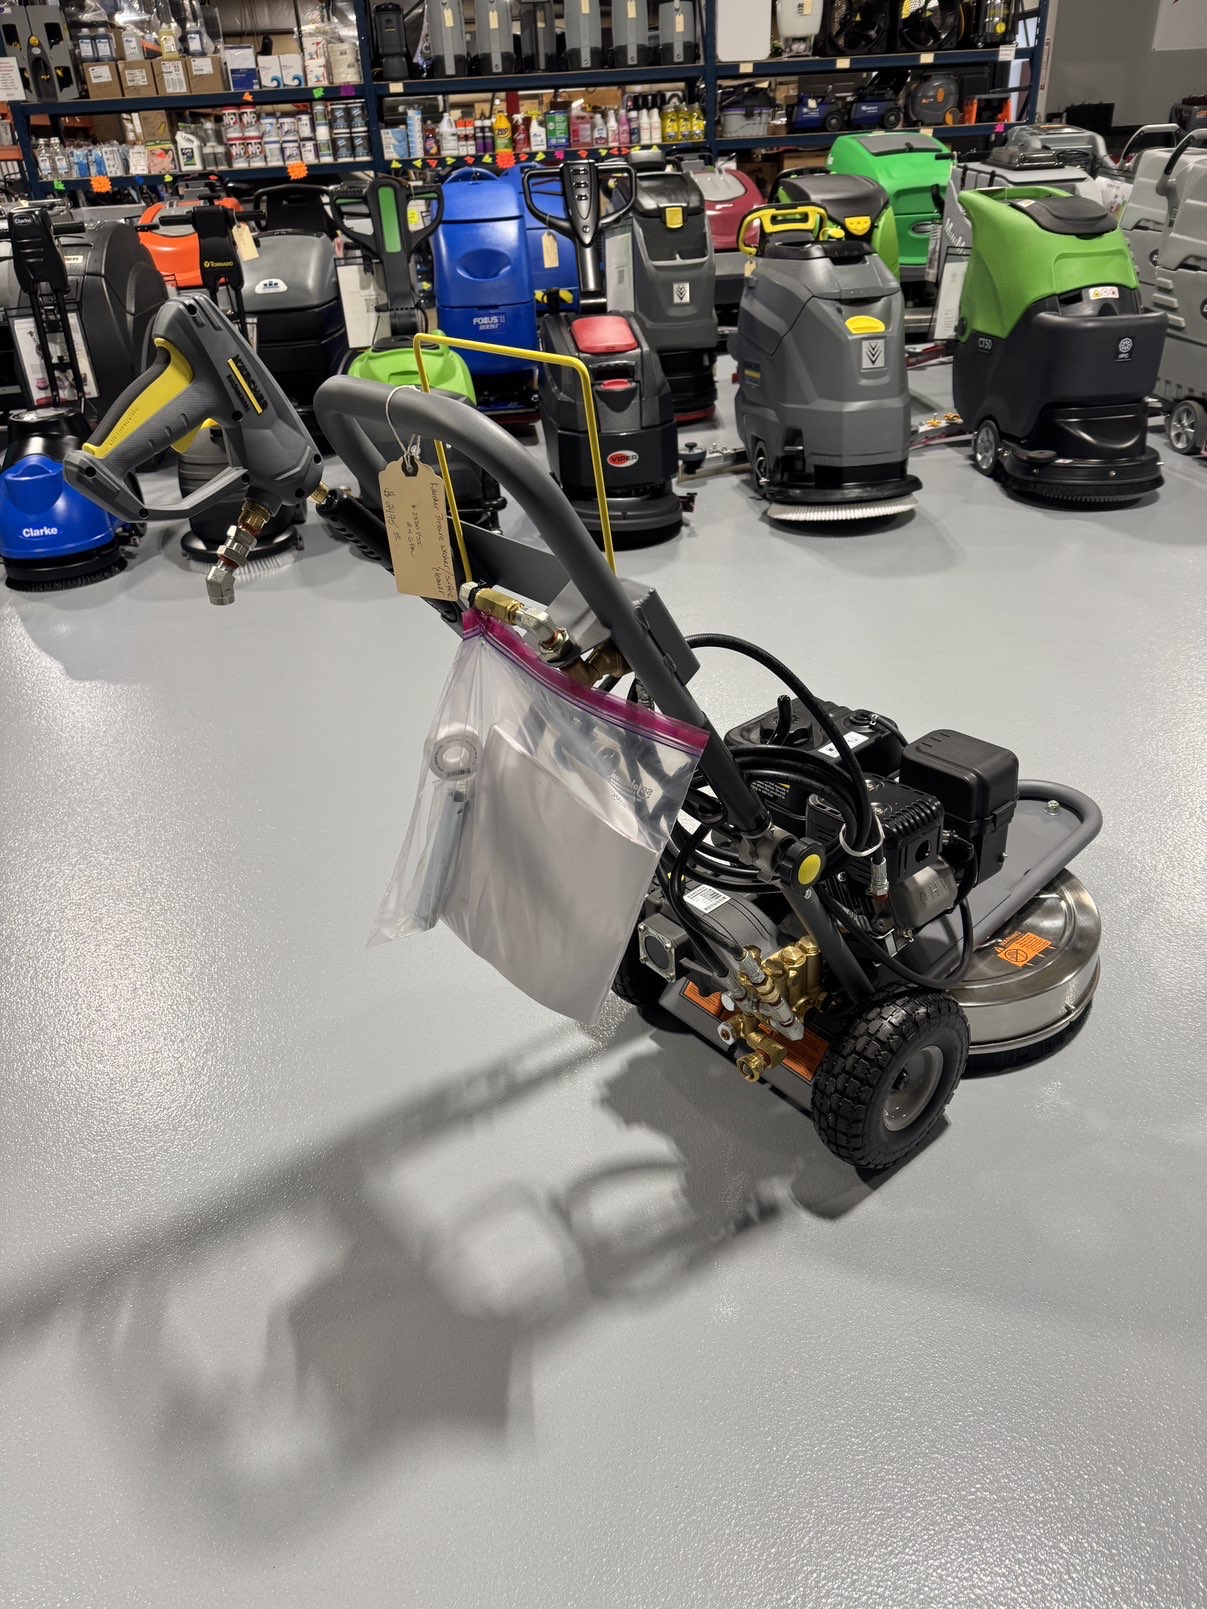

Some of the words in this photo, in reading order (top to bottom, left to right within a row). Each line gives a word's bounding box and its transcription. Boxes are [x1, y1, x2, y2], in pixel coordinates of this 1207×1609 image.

[14, 216, 32, 225] Clarke
[473, 316, 499, 325] FOCUS
[611, 454, 638, 463] VIPER
[22, 525, 58, 538] Clarke
